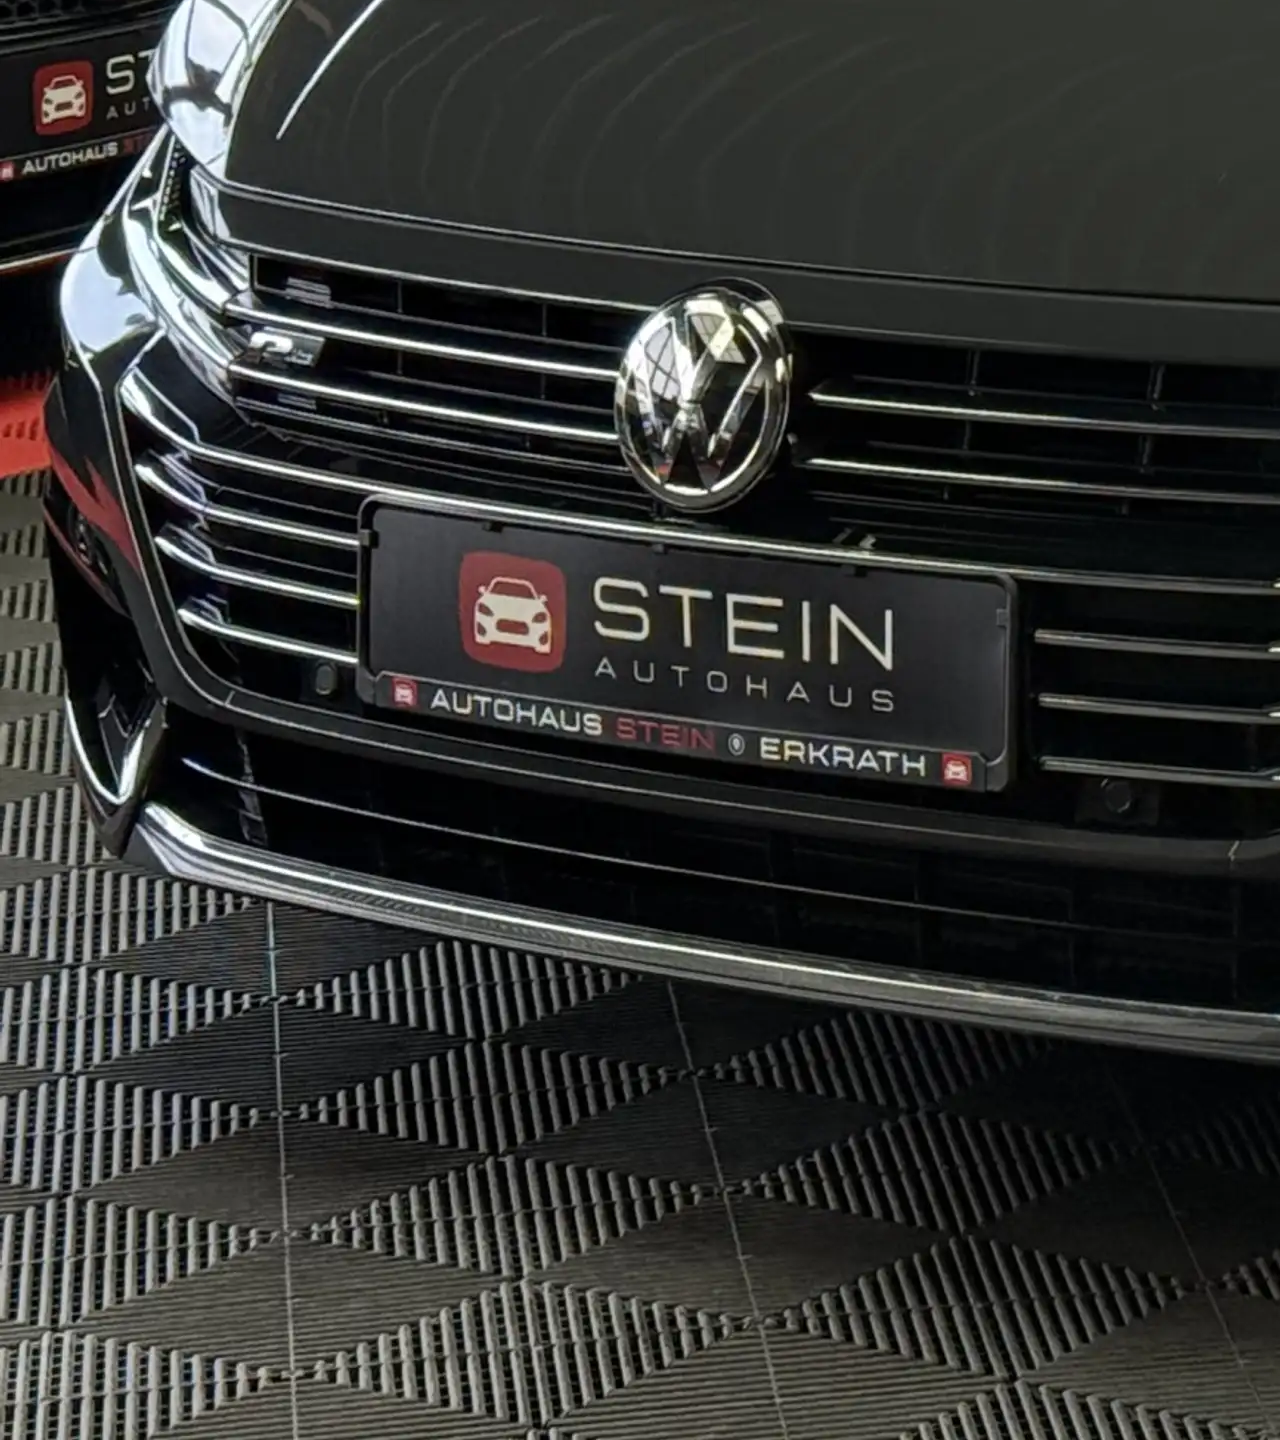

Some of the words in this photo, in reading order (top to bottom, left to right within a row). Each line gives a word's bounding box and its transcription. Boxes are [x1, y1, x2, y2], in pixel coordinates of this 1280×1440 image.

[21, 141, 119, 175] AUTOHAUS
[592, 575, 895, 671] STEIN
[594, 656, 896, 713] AUTOHAUS
[430, 687, 604, 736] AUTOHAUS
[615, 716, 715, 752] STEIN
[759, 737, 927, 778] ERKRATH
